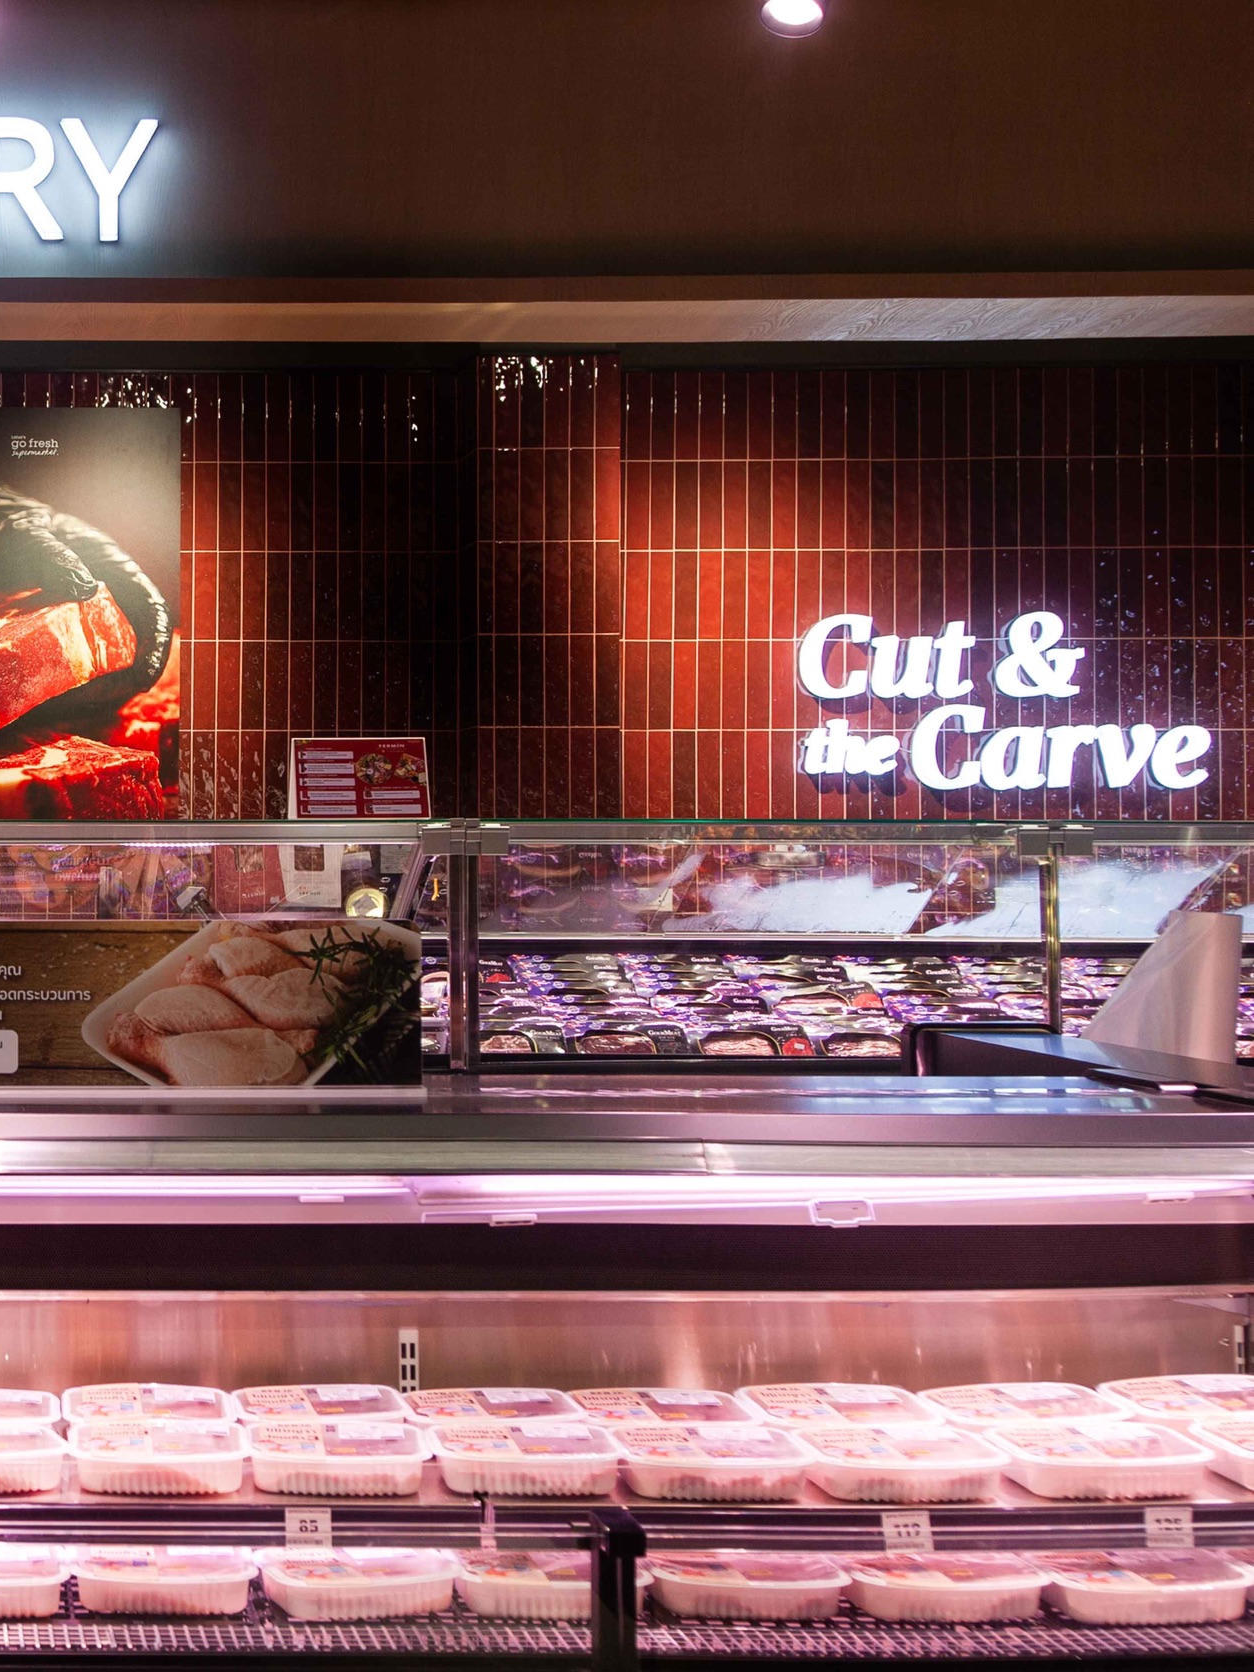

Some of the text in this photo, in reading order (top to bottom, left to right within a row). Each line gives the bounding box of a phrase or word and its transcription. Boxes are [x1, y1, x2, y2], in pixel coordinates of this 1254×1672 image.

[11, 438, 59, 450] go fresh
[799, 610, 1084, 700] Cut &
[803, 704, 1212, 791] the Carve
[893, 1523, 921, 1537] 119
[1155, 1518, 1183, 1531] 125
